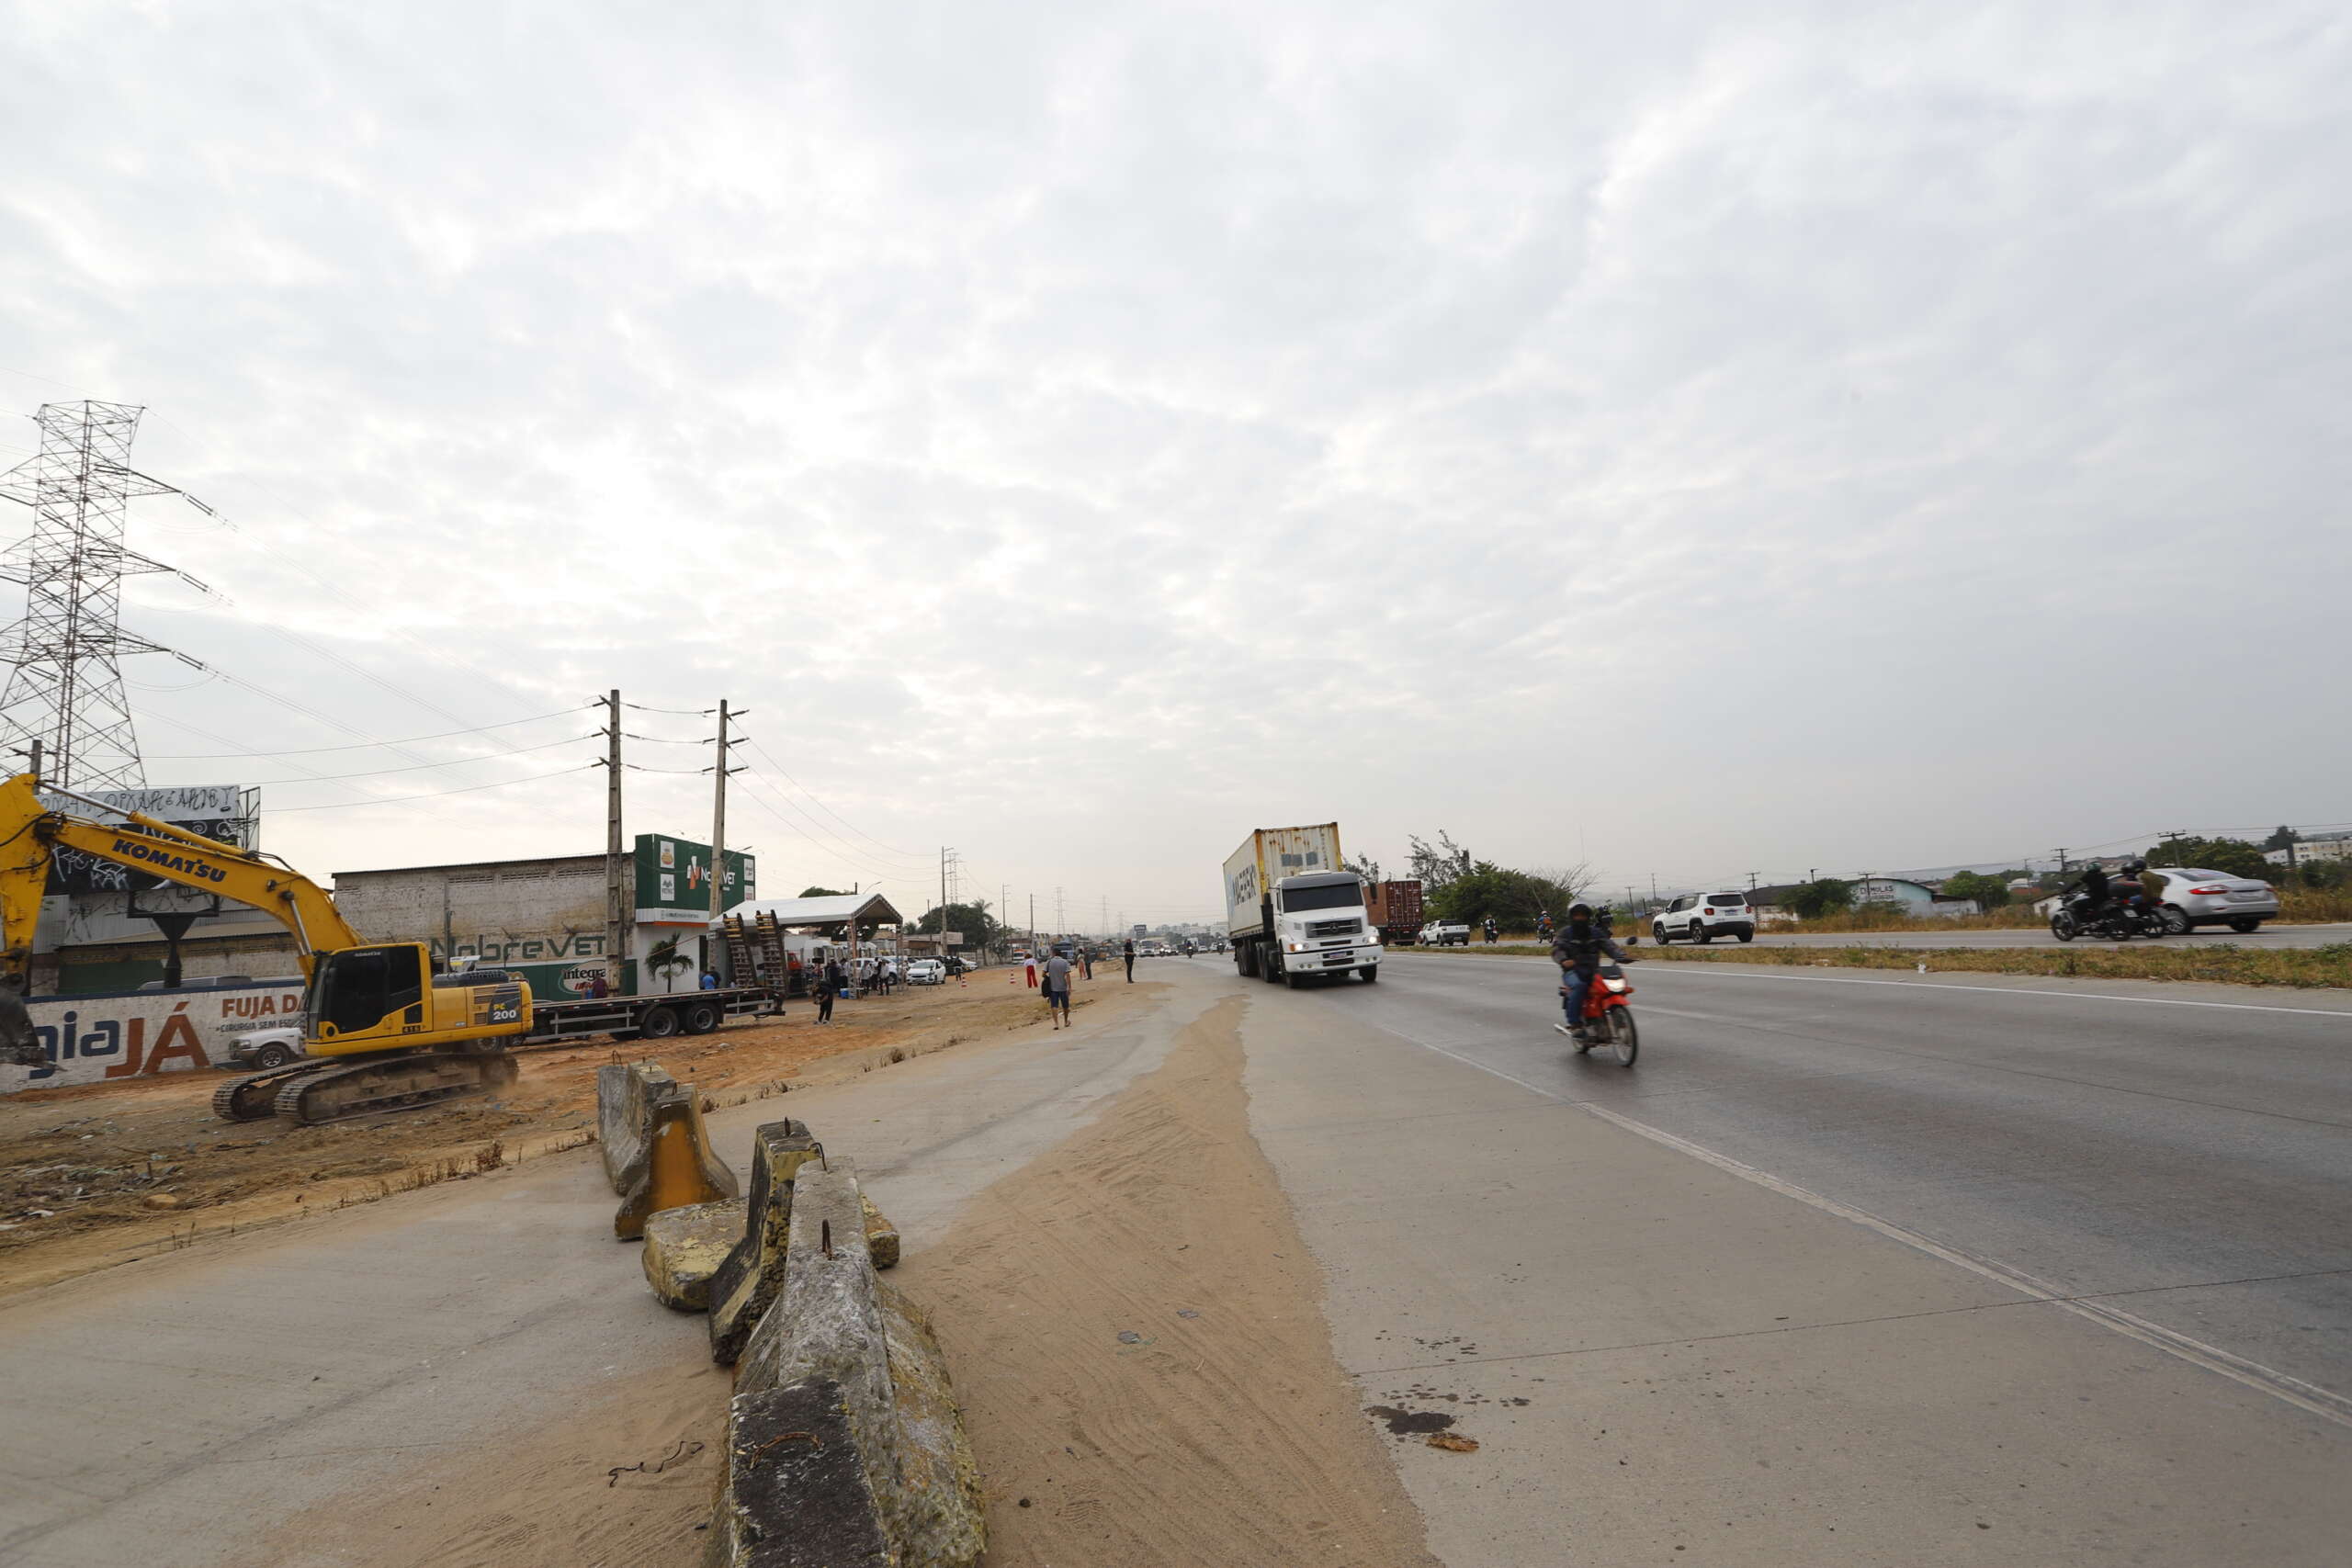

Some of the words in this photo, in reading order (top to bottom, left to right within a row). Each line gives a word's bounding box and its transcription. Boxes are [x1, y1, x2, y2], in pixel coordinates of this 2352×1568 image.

[112, 838, 227, 883] KOMATSU
[221, 995, 276, 1020] FUJA
[282, 993, 301, 1014] D
[493, 1010, 516, 1021] 200
[220, 1021, 256, 1032] CIRURGIA
[258, 1020, 277, 1030] SEM
